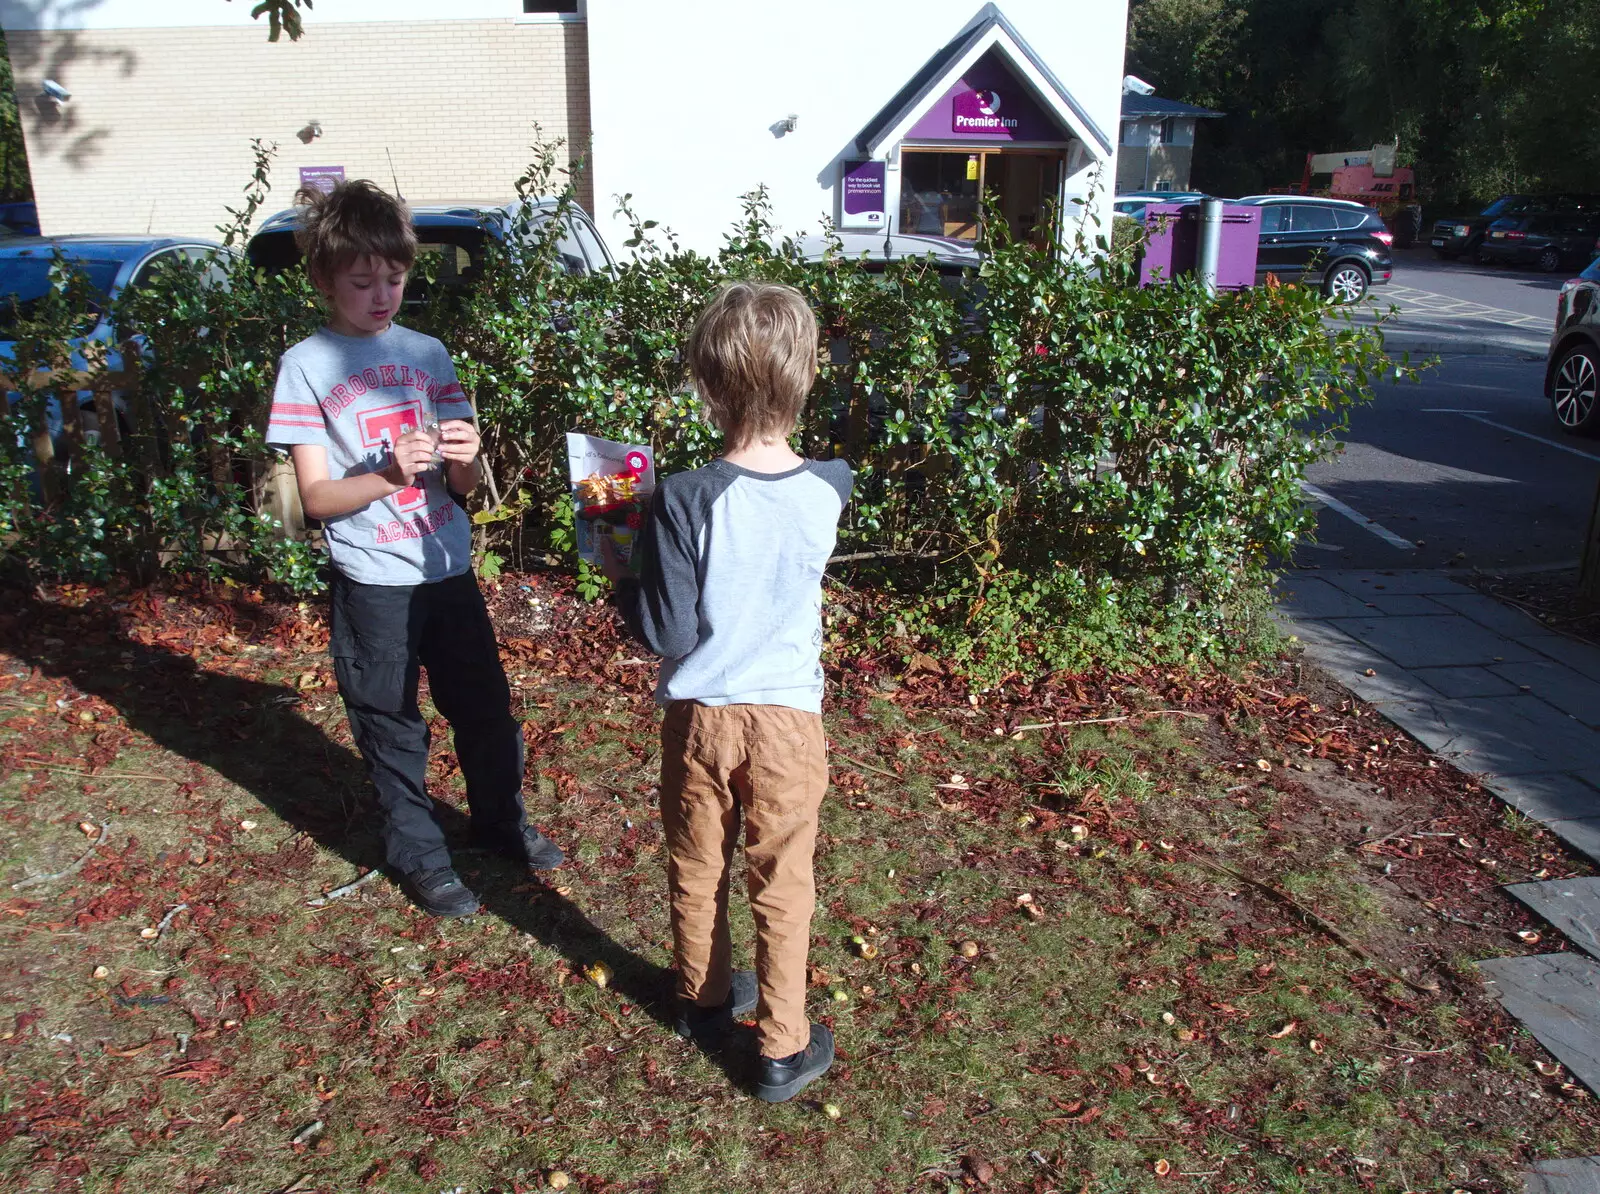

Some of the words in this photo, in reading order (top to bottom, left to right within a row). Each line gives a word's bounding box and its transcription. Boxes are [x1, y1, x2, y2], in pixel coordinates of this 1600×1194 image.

[956, 115, 1000, 127] Premier
[1001, 116, 1018, 127] Inn
[1370, 183, 1394, 192] JLG
[321, 364, 441, 419] BROOKLYN
[376, 501, 455, 544] ACADEMY
